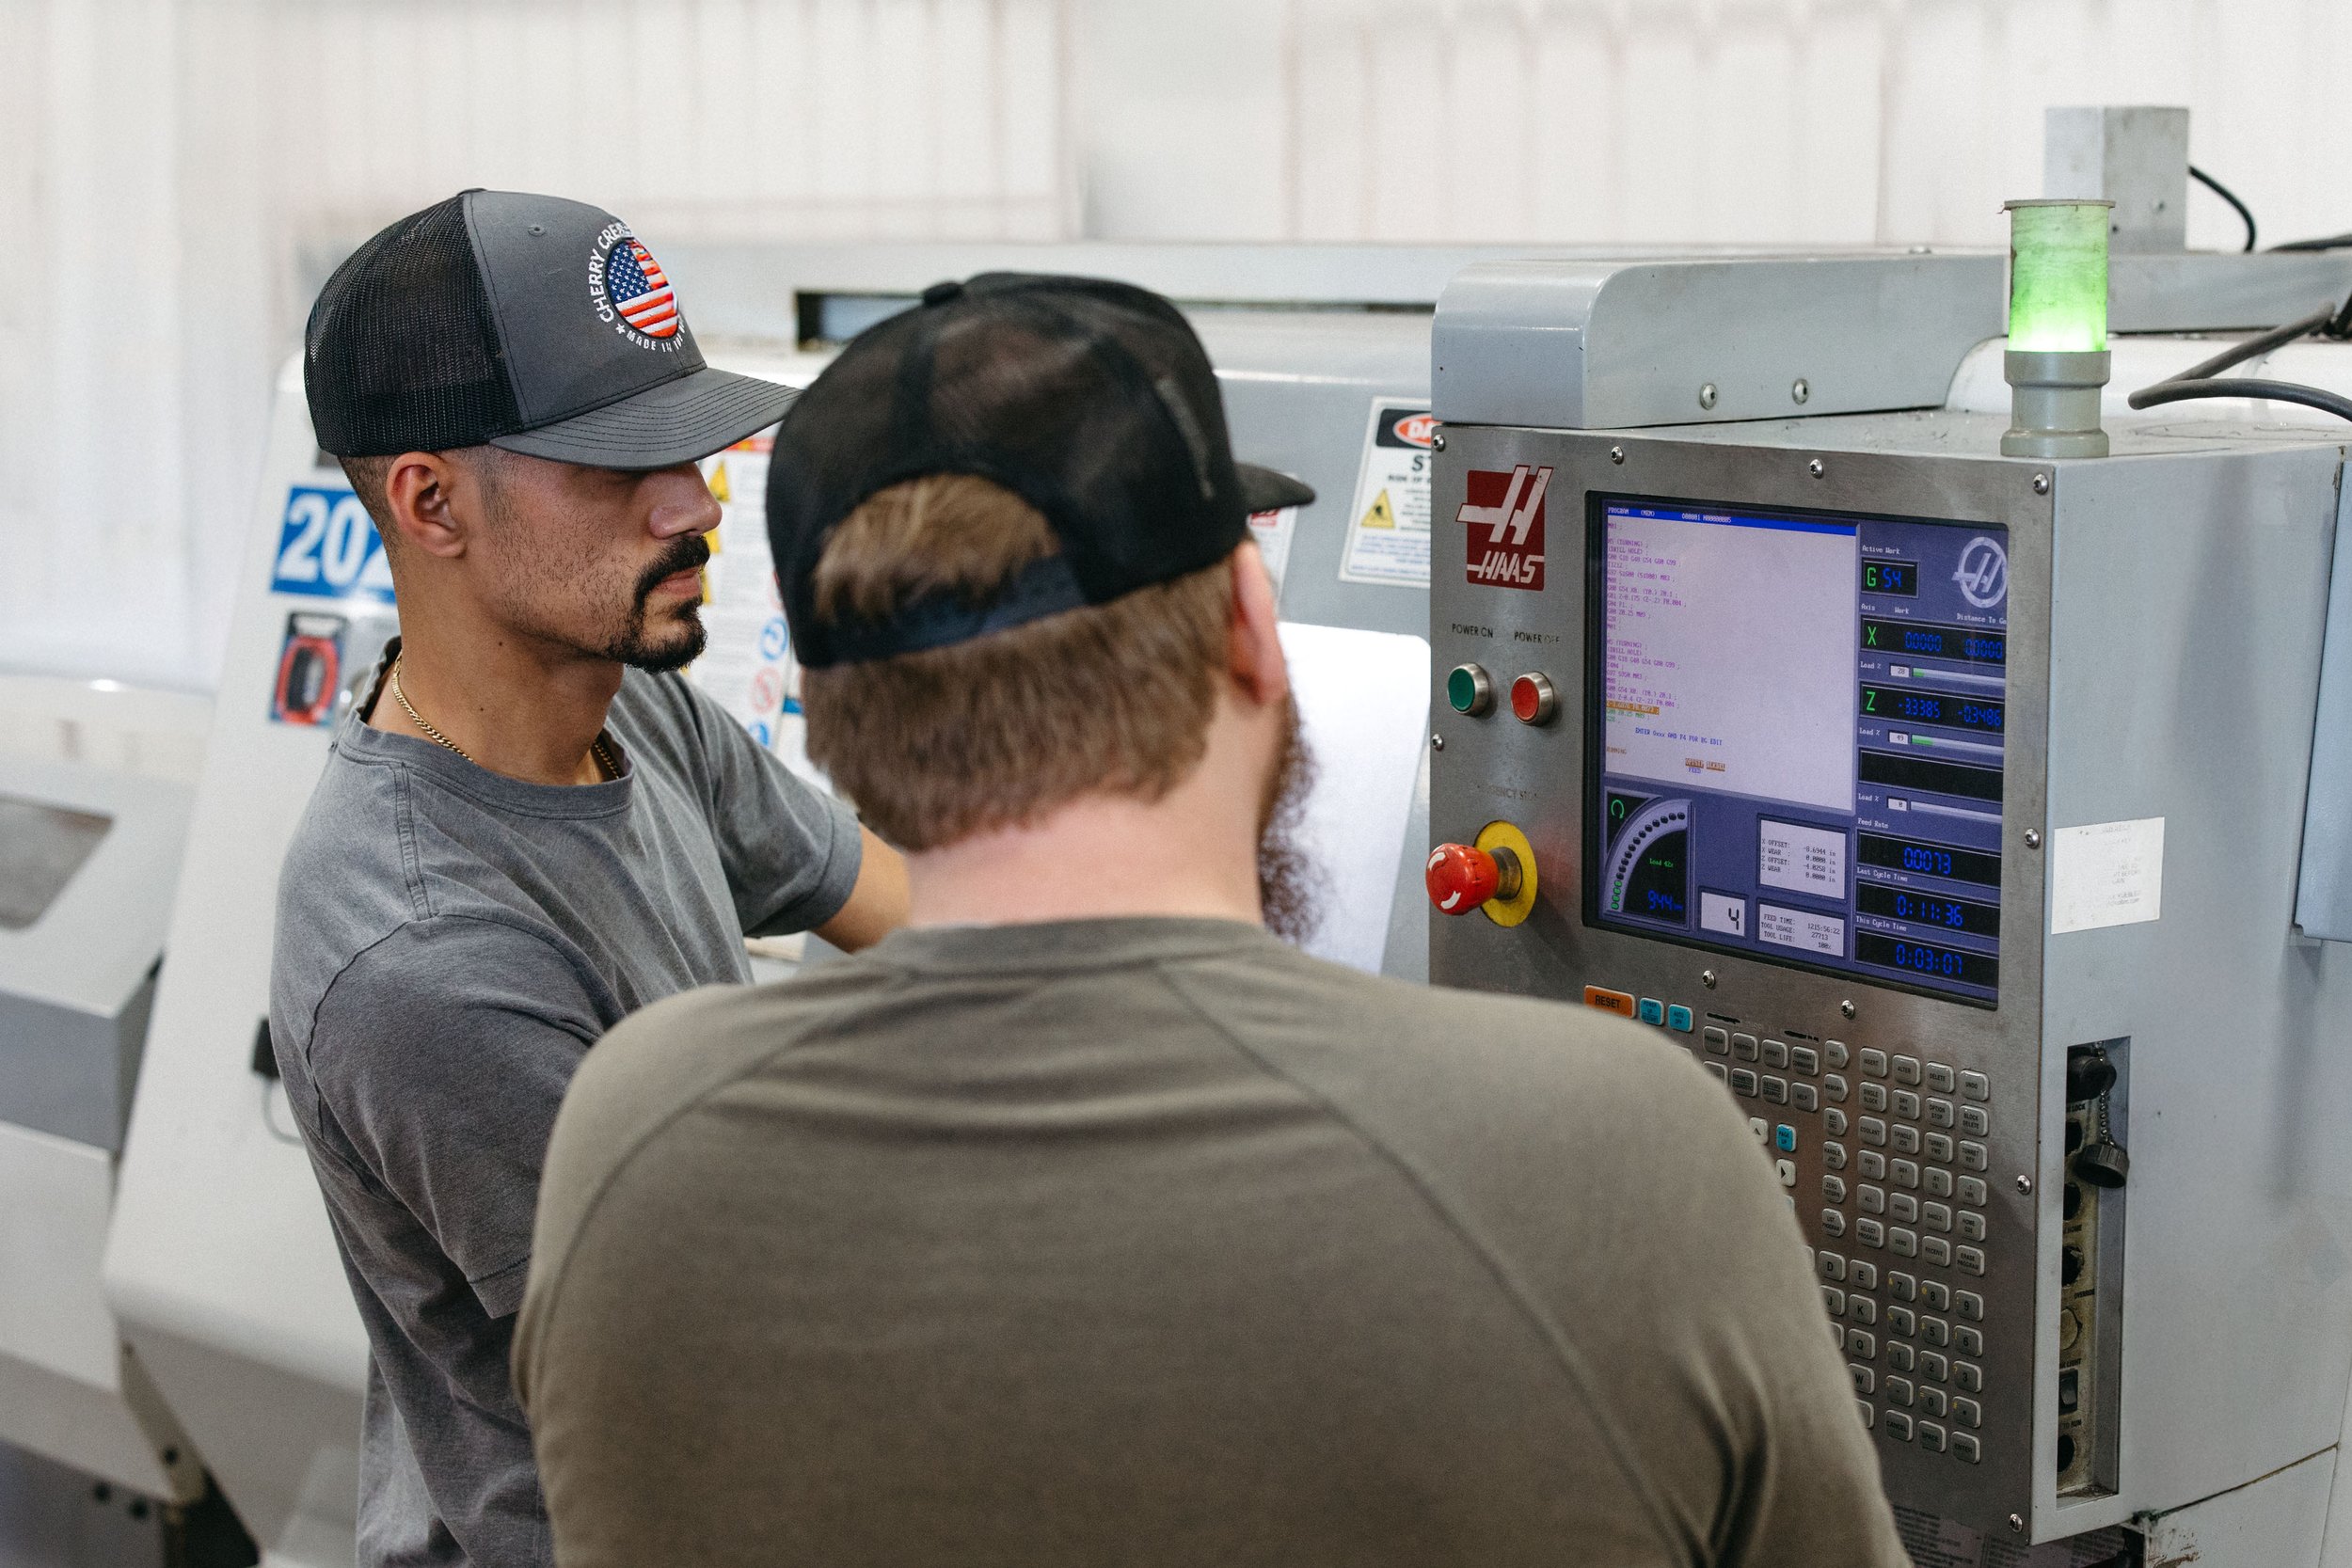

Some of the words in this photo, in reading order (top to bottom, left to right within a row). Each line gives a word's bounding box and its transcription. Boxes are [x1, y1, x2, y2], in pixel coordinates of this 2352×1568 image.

[589, 248, 614, 323] CHERRY
[627, 330, 656, 351] MADE
[661, 342, 673, 353] IN
[1862, 545, 1883, 553] Active
[1885, 546, 1900, 555] Work
[1467, 550, 1545, 584] HAAS
[1867, 566, 1877, 588] G
[1883, 567, 1901, 589] 54
[1861, 603, 1875, 611] Axis
[1957, 613, 1986, 623] Distance
[1452, 623, 1479, 637] POWER
[1481, 626, 1494, 639] ON
[1867, 626, 1877, 646] X
[1514, 631, 1542, 643] POWER
[1866, 690, 1876, 711] Z
[1859, 727, 1874, 736] Load
[1709, 737, 1723, 746] EDIT
[1858, 793, 1873, 801] Load
[1857, 817, 1872, 826] Feed
[1874, 820, 1889, 829] Rate
[1857, 867, 1871, 876] Last
[1873, 869, 1891, 879] Cycle
[1893, 873, 1908, 881] Time
[1728, 907, 1740, 930] 4
[1763, 913, 1777, 922] FEED
[1780, 916, 1795, 925] TIME:
[1807, 923, 1840, 935] 1215:56:22
[1856, 916, 1869, 925] This
[1872, 919, 1891, 928] Cycle
[1892, 923, 1907, 932] Time
[1761, 922, 1774, 930] TOOL
[1776, 925, 1795, 933] USAGE:
[1811, 932, 1829, 941] 27713
[1764, 930, 1777, 939] TOOL
[1896, 943, 1963, 974] 0:03:07
[1595, 995, 1621, 1008] RESET
[1765, 1049, 1780, 1057] OFFSET
[1898, 1065, 1911, 1074] ALTER
[1930, 1073, 1946, 1082] DELETE
[1825, 1083, 1842, 1092] MEMORY
[1863, 1088, 1878, 1097] SINGLE
[1864, 1096, 1878, 1104] BLOCK
[1930, 1104, 1946, 1114] OPTION
[1963, 1113, 1979, 1121] BLOCK
[1963, 1120, 1979, 1130] DELETE
[1860, 1126, 1881, 1136] COOLANT
[1894, 1132, 1912, 1141] SPINDLE
[1929, 1139, 1945, 1148] TURRET
[1824, 1148, 1841, 1157] HANDLE
[1931, 1148, 1941, 1156] FWD
[1962, 1148, 1979, 1157] TURRET
[1826, 1181, 1837, 1190] ZERO
[1860, 1225, 1876, 1234] SELECT
[1858, 1231, 1879, 1243] PROGRAM
[1895, 1238, 1907, 1246] SEND
[1961, 1252, 1975, 1261] ERASE
[1827, 1261, 1834, 1271] D
[1957, 1259, 1979, 1270] PROGRAM
[1858, 1270, 1864, 1280] E
[1897, 1281, 1902, 1291] 7
[1827, 1296, 1833, 1307] J
[1930, 1291, 1936, 1302] 8
[1857, 1305, 1864, 1316] K
[1963, 1301, 1970, 1311] 9
[1896, 1317, 1902, 1327] 4
[1929, 1326, 1935, 1337] 5
[1856, 1339, 1864, 1351] Q
[1963, 1336, 1969, 1347] 6
[1897, 1352, 1901, 1362] 1
[1929, 1362, 1934, 1372] 2
[1854, 1373, 1864, 1386] W
[1963, 1372, 1968, 1383] 3
[1928, 1398, 1933, 1408] 0
[1885, 1419, 1907, 1433] CANCEL
[1954, 1442, 1973, 1454] ENTER
